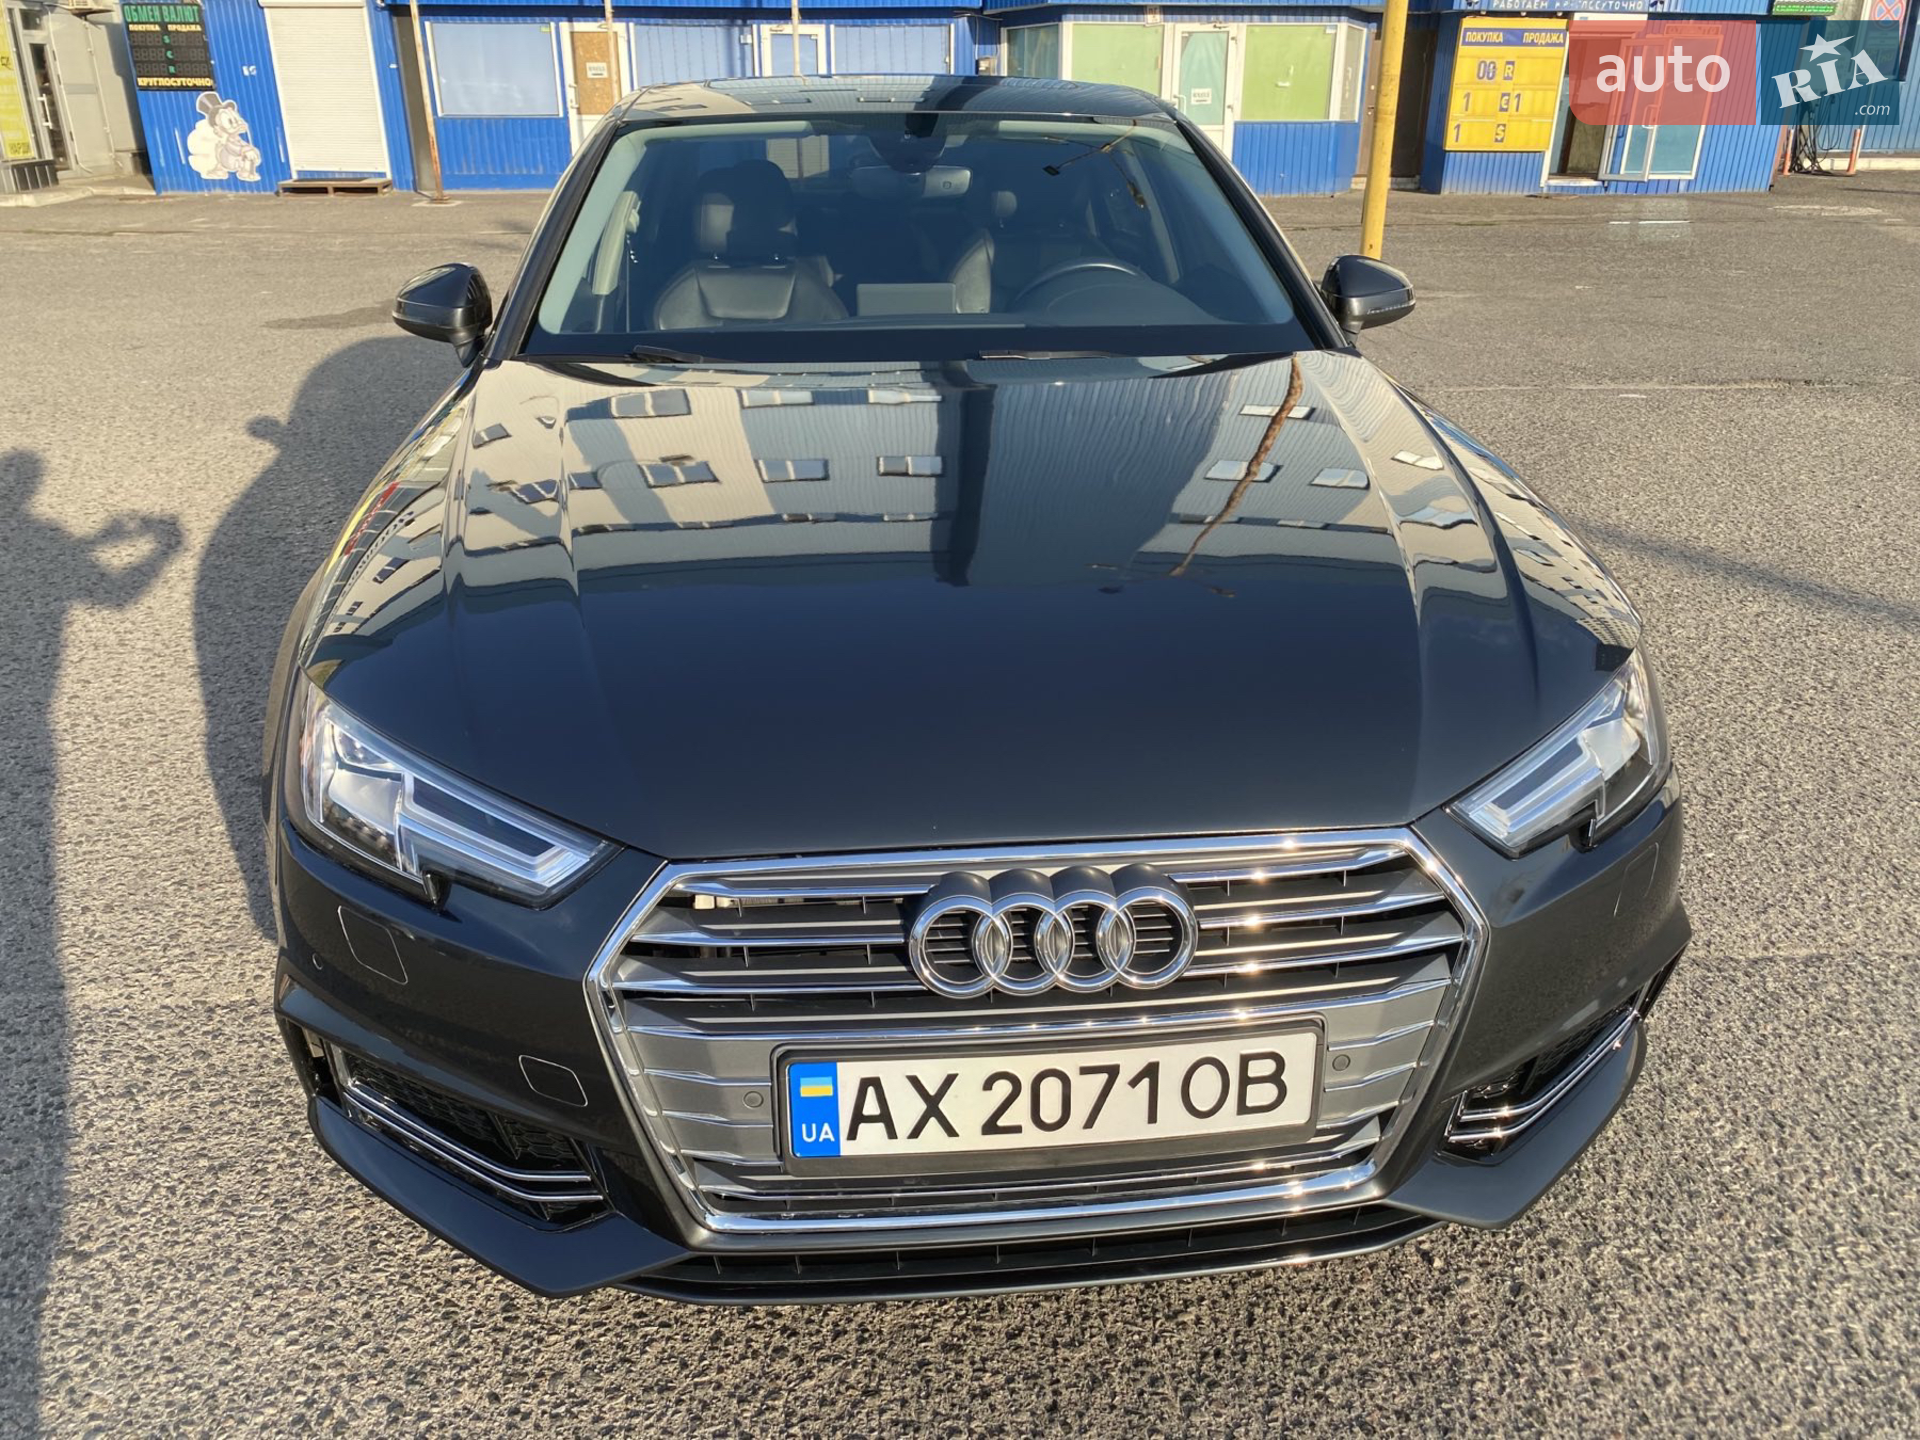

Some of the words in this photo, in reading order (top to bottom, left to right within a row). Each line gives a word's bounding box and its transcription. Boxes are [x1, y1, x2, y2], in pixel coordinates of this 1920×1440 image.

[124, 5, 160, 22] ОБМЕН
[162, 5, 199, 22] ВАЛЮТ
[1465, 31, 1504, 43] ПОКУПКА
[1522, 33, 1564, 45] ПРОДАЖА
[137, 77, 212, 86] КРУГЛОСУТОЧНО
[1463, 92, 1471, 111] 1
[1514, 93, 1521, 112] 1
[1454, 123, 1461, 142] 1
[846, 1073, 960, 1141] AX
[981, 1061, 1160, 1136] 2071
[1180, 1050, 1288, 1119] OB
[802, 1121, 835, 1142] UA
